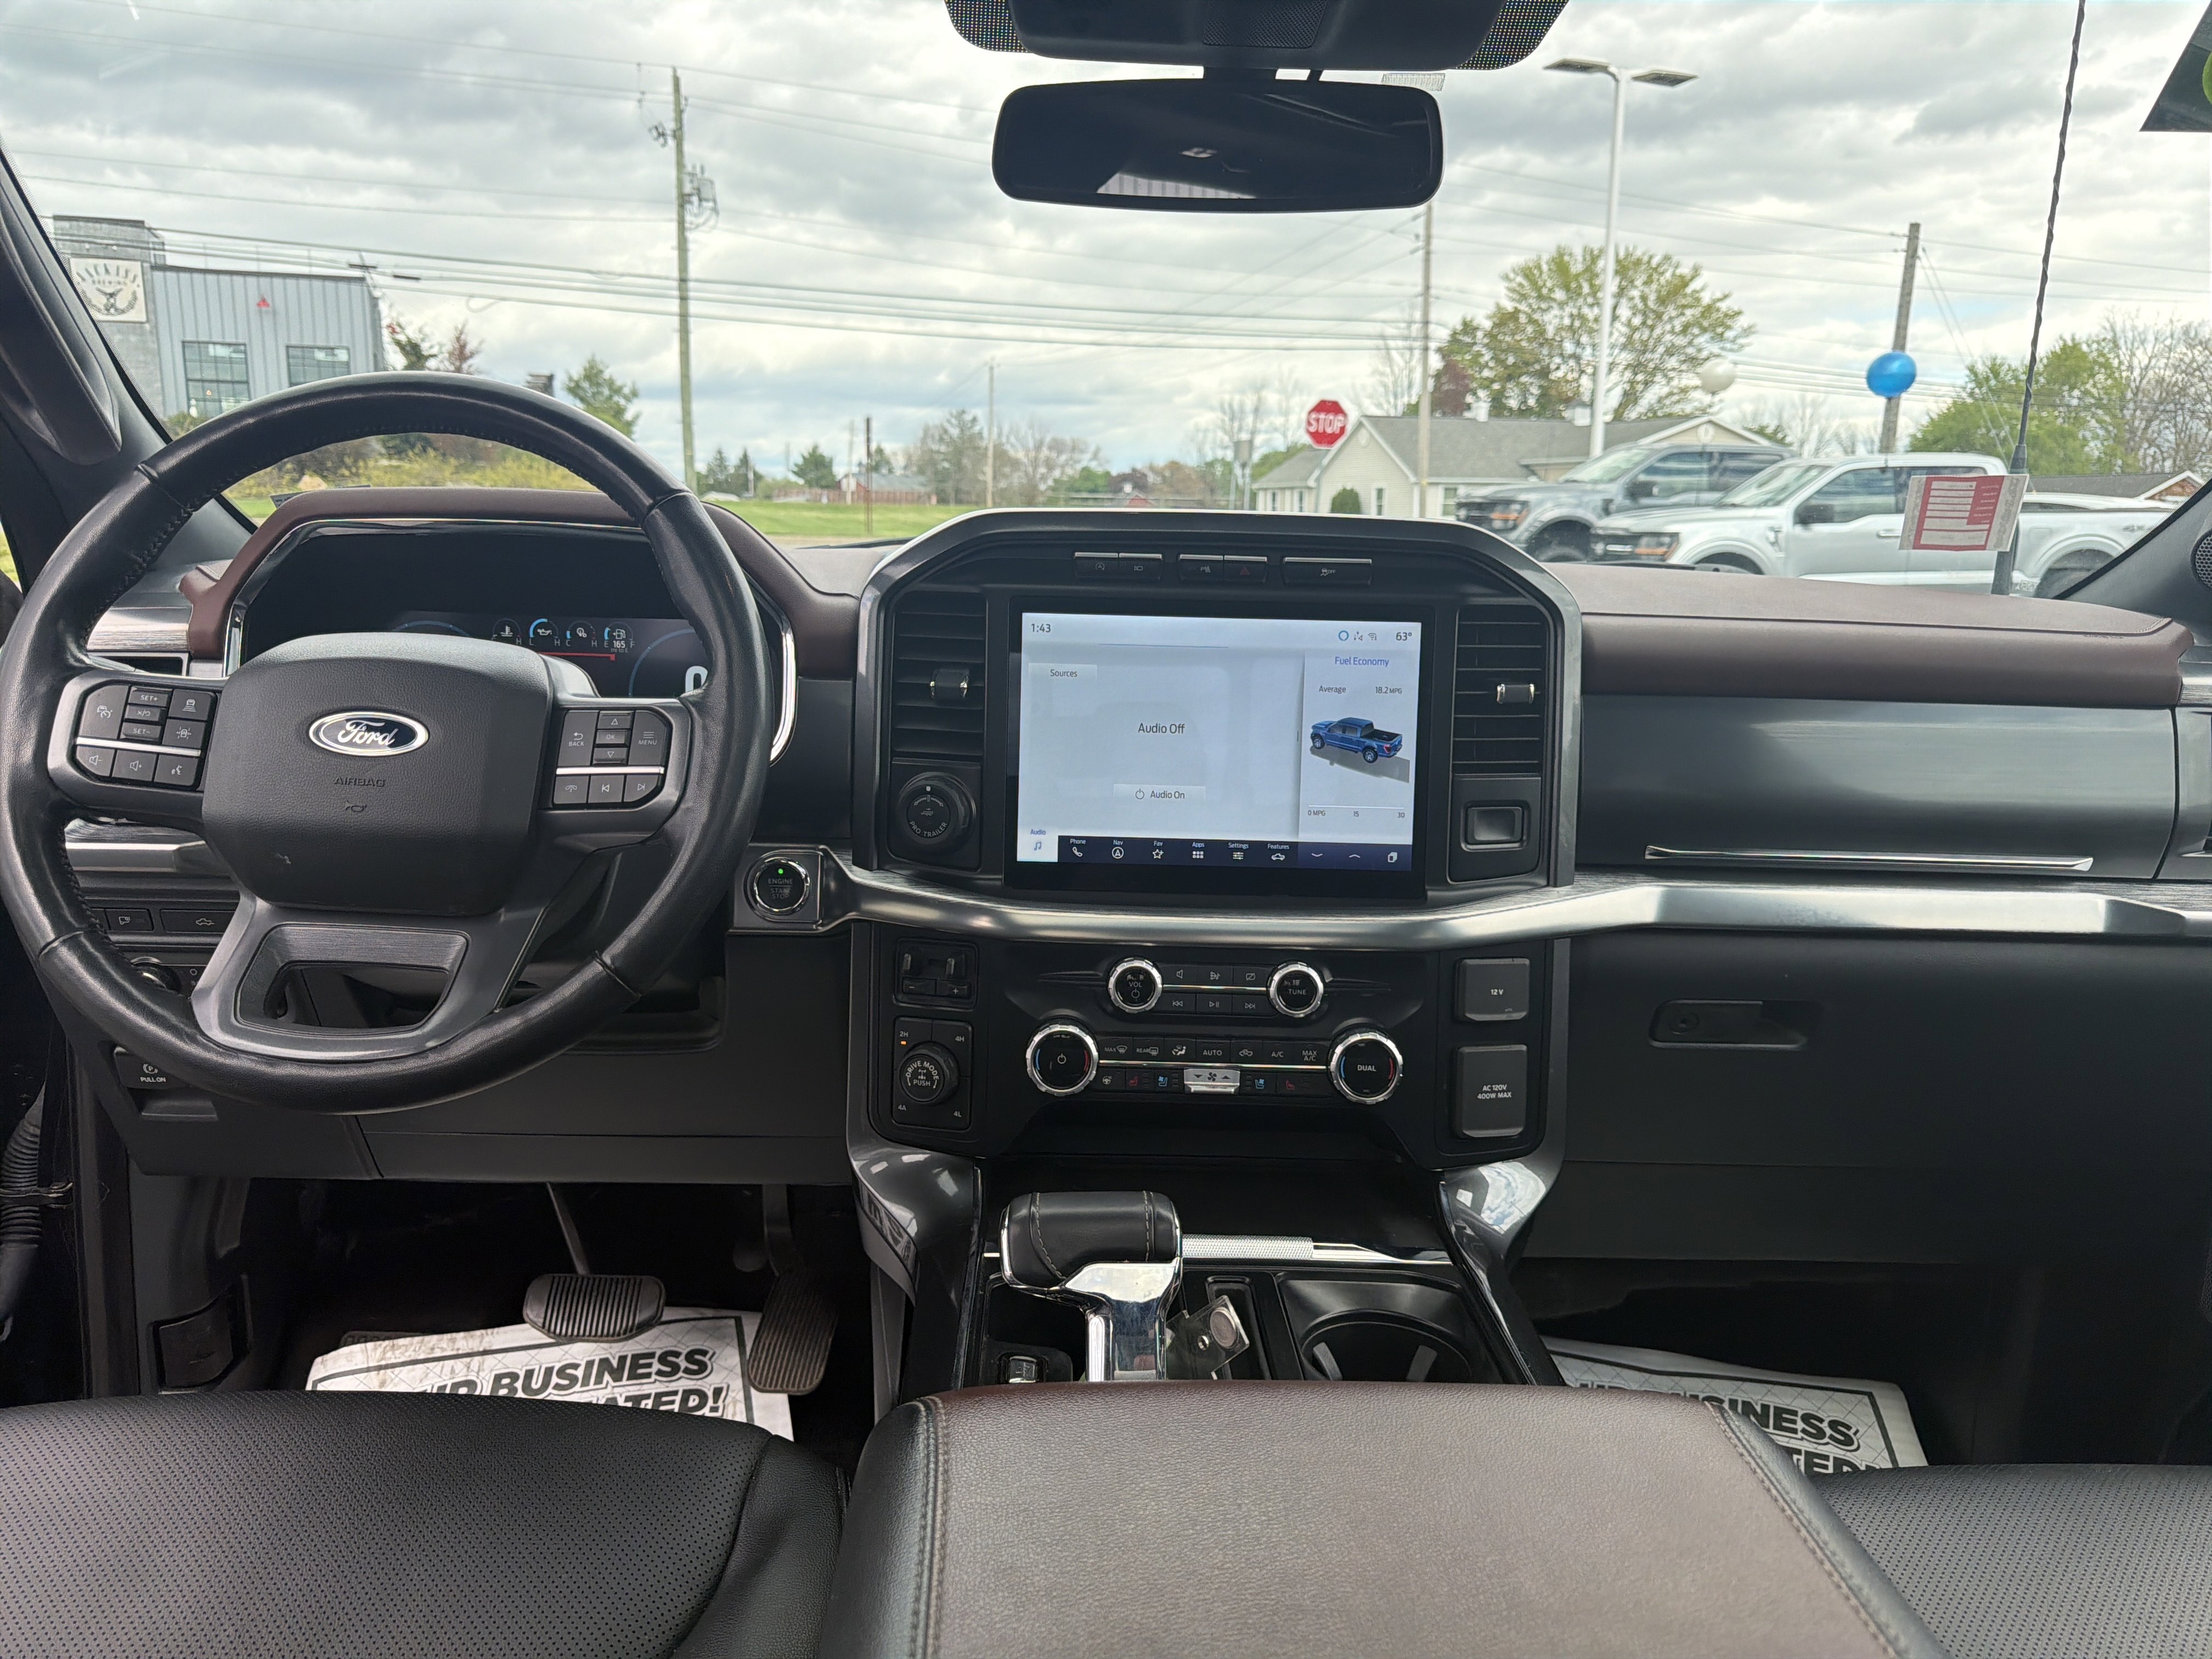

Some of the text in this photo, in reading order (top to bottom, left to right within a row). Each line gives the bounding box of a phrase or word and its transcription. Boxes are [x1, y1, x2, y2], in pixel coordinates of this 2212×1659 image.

[1307, 411, 1346, 433] STOP
[1031, 623, 1052, 633] 1:43
[1396, 632, 1413, 641] 63°
[1335, 657, 1390, 667] Fuel Economy
[1319, 686, 1346, 694] Average
[337, 720, 398, 746] Ford
[1138, 723, 1185, 734] Audio Off
[334, 777, 385, 787] AIRBAG
[1150, 790, 1185, 799] Audio On
[909, 821, 949, 838] PRO TRAILER
[905, 1060, 940, 1080] DRIVE MODE
[490, 1348, 713, 1399] BUSINESS
